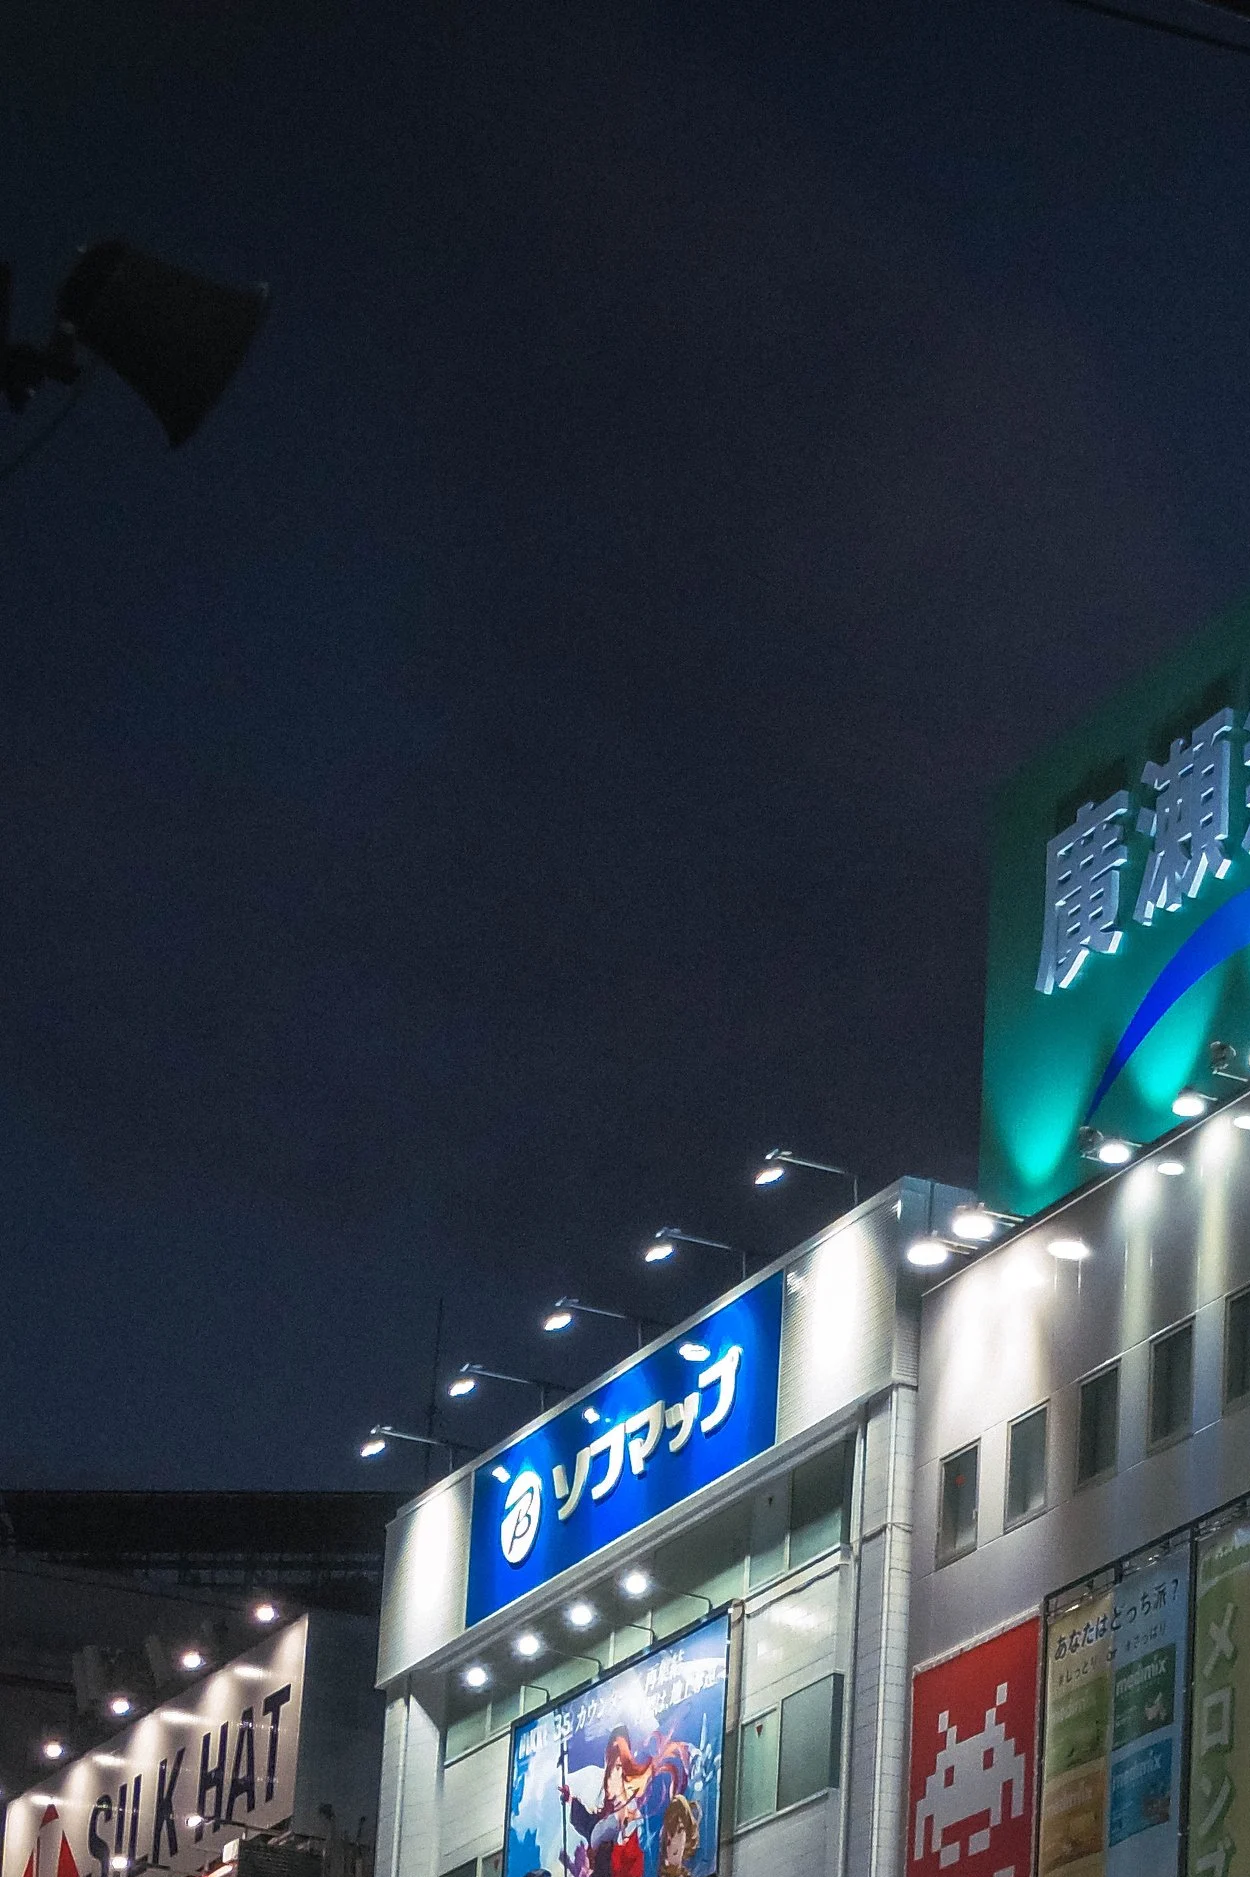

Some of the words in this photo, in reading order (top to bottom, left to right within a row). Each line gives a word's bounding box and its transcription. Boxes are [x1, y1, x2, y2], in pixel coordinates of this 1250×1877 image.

[554, 1345, 743, 1521] ソフマップ
[195, 1684, 291, 1846] HAT
